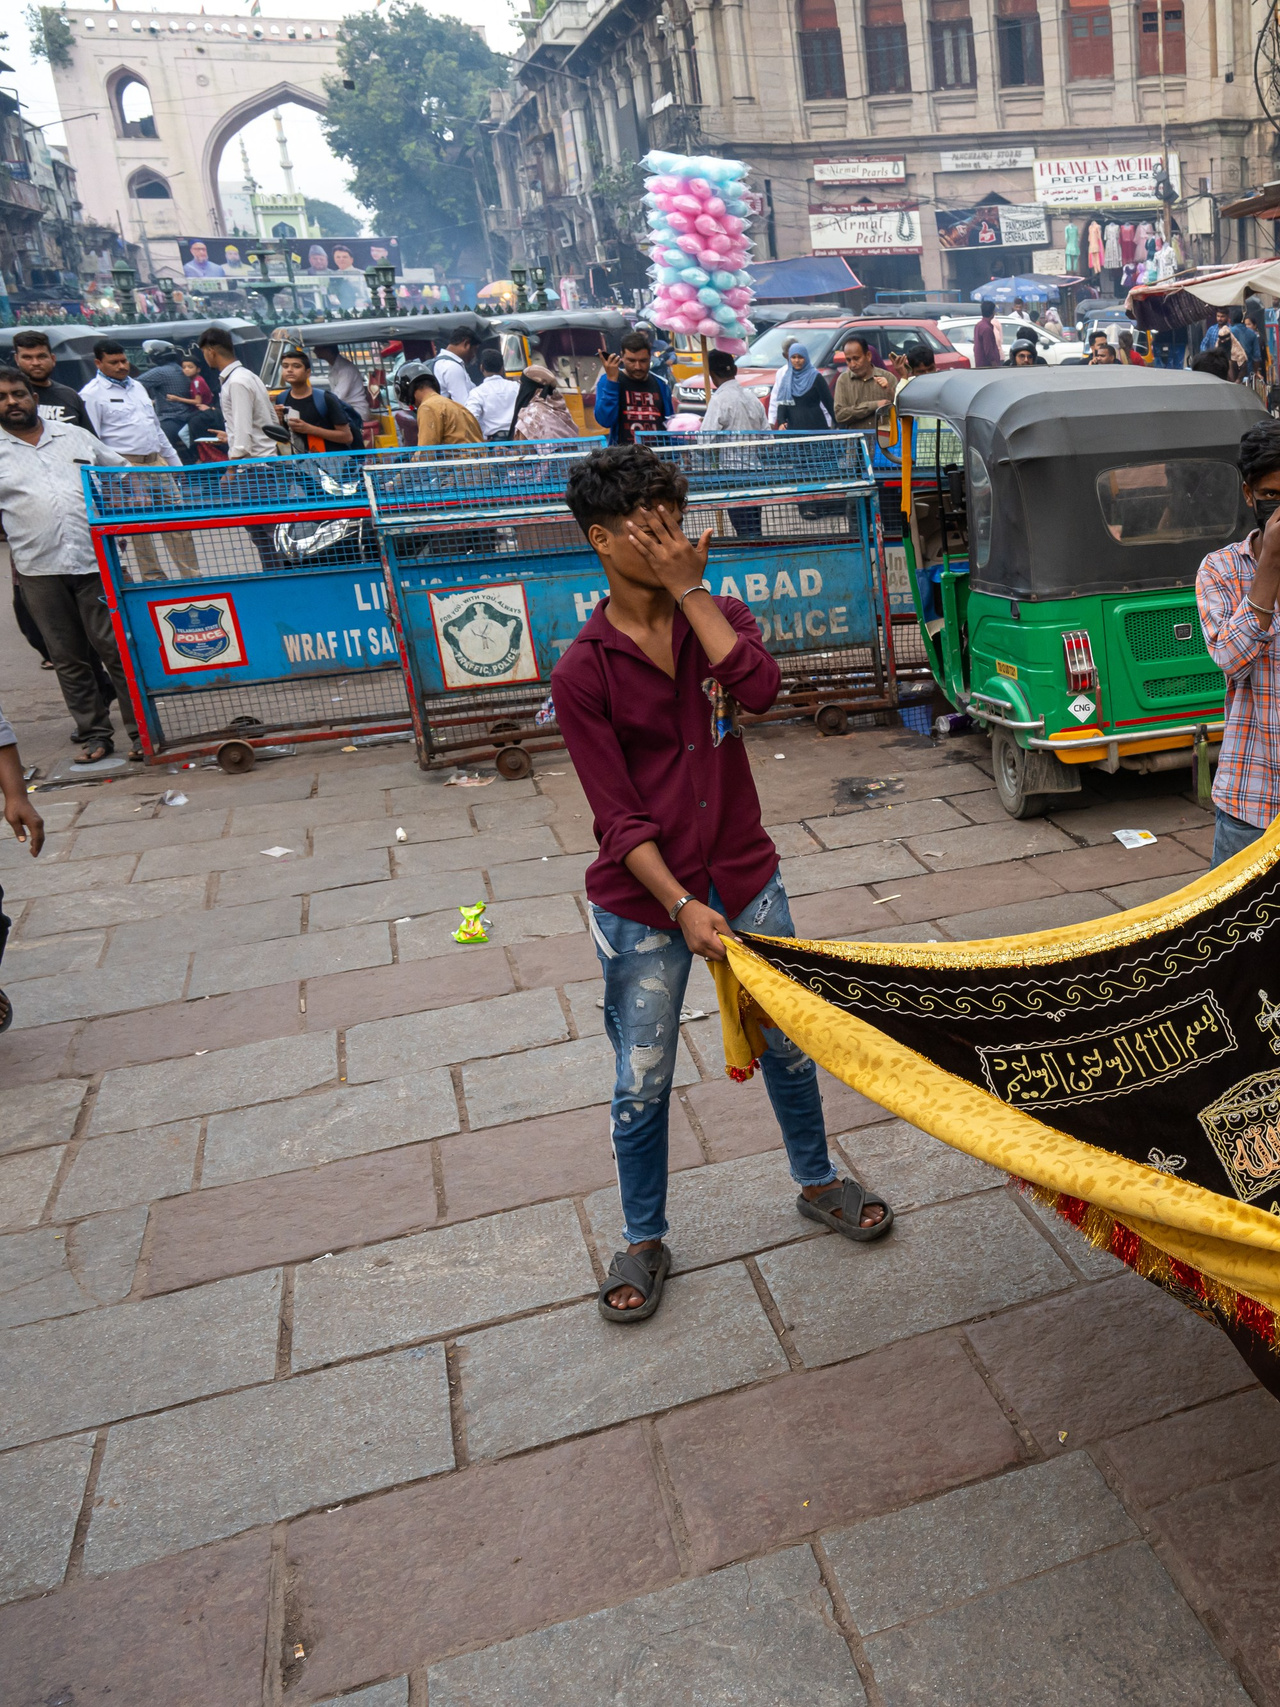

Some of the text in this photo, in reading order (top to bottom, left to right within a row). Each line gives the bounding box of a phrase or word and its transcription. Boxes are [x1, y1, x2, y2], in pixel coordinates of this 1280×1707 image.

[827, 165, 888, 177] Nirmal Pearls
[1039, 160, 1109, 176] PURANDAS
[832, 215, 884, 234] Nirmal
[856, 231, 893, 244] Pearls
[1004, 230, 1046, 243] GENERAL STORE
[440, 614, 453, 623] FOR
[463, 594, 480, 605] WITH
[497, 600, 522, 614] ALWAYS
[205, 623, 219, 632] STATE
[1177, 628, 1190, 638] RE
[177, 629, 223, 642] POLICE
[283, 630, 338, 663] WRAF
[342, 628, 362, 658] IT
[455, 648, 518, 674] TRAFFIC POLICE
[1073, 703, 1091, 713] CNG
